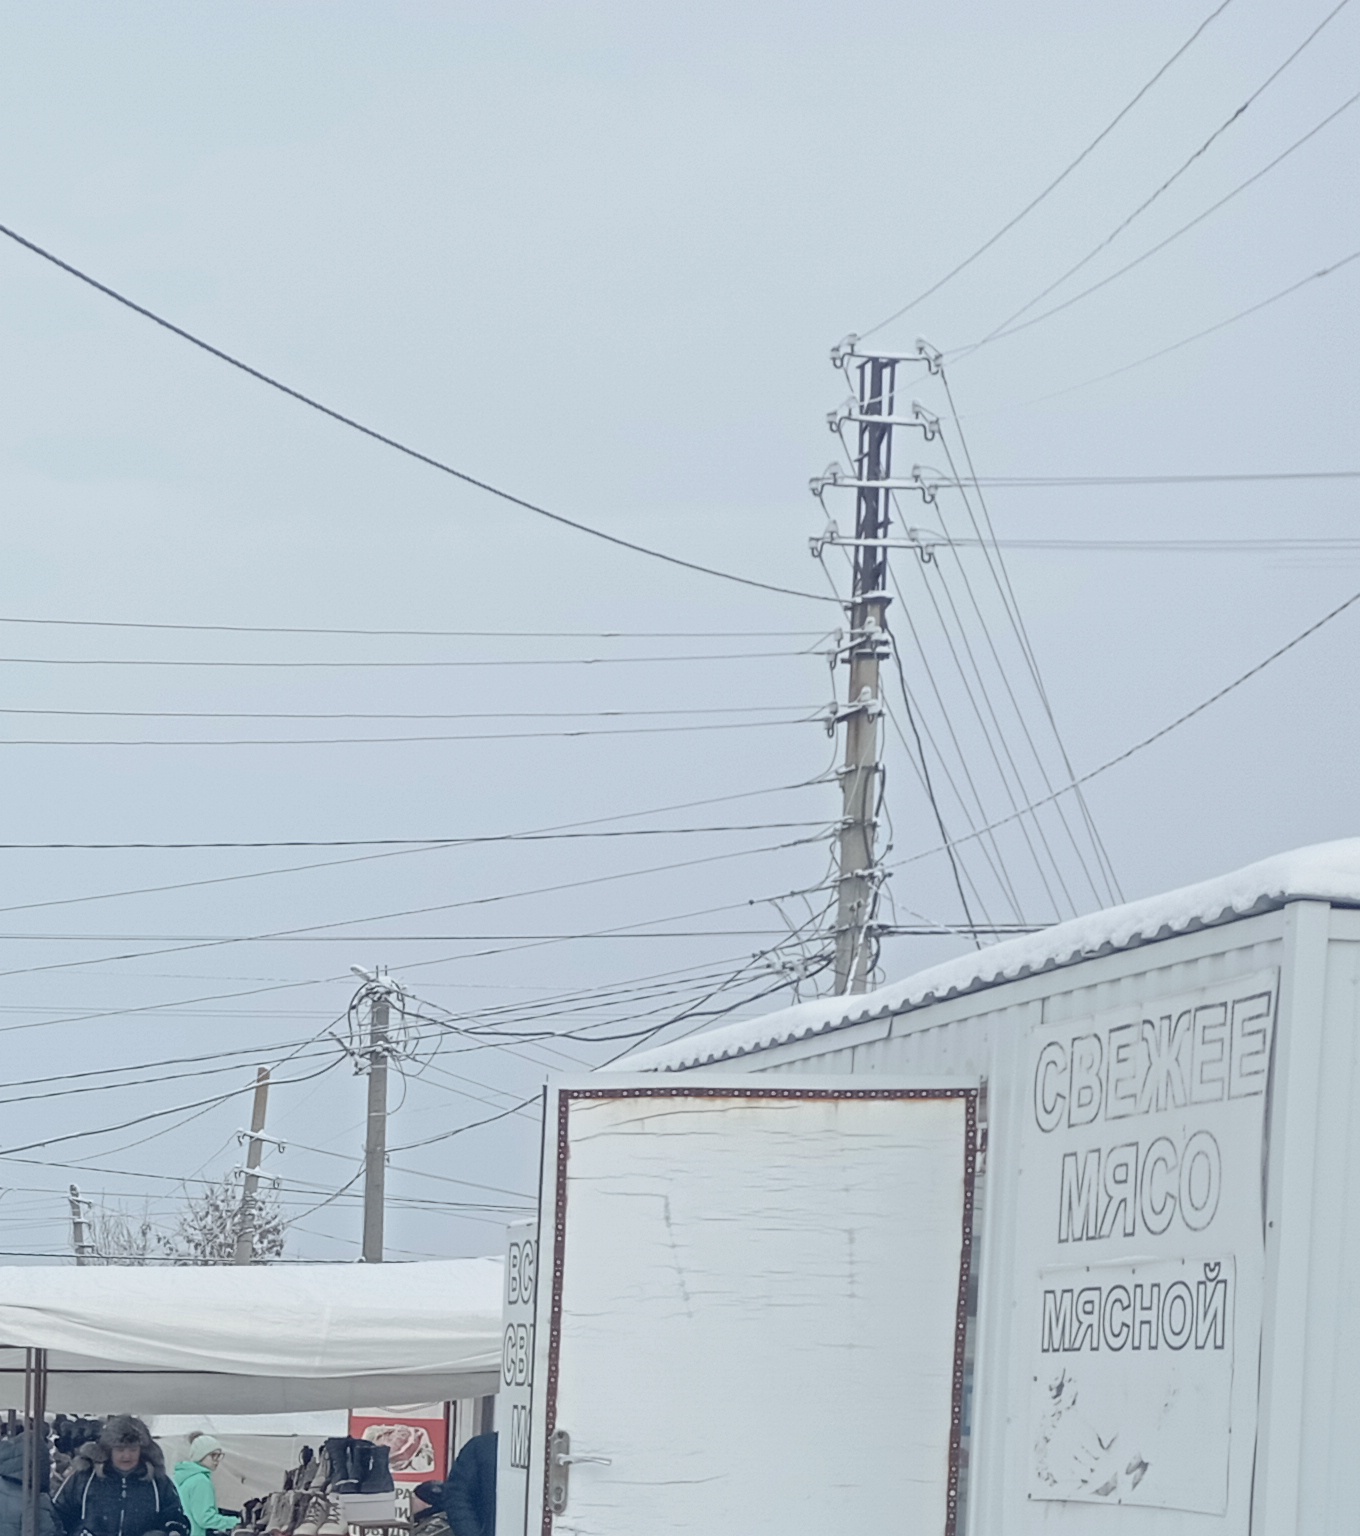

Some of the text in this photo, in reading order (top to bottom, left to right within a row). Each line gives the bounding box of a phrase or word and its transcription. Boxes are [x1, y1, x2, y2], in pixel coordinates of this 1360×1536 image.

[1034, 991, 1272, 1134] СВЕЖЕЕ
[1058, 1129, 1222, 1244] МЯСО
[1041, 1261, 1228, 1353] МЯСНОЙ
